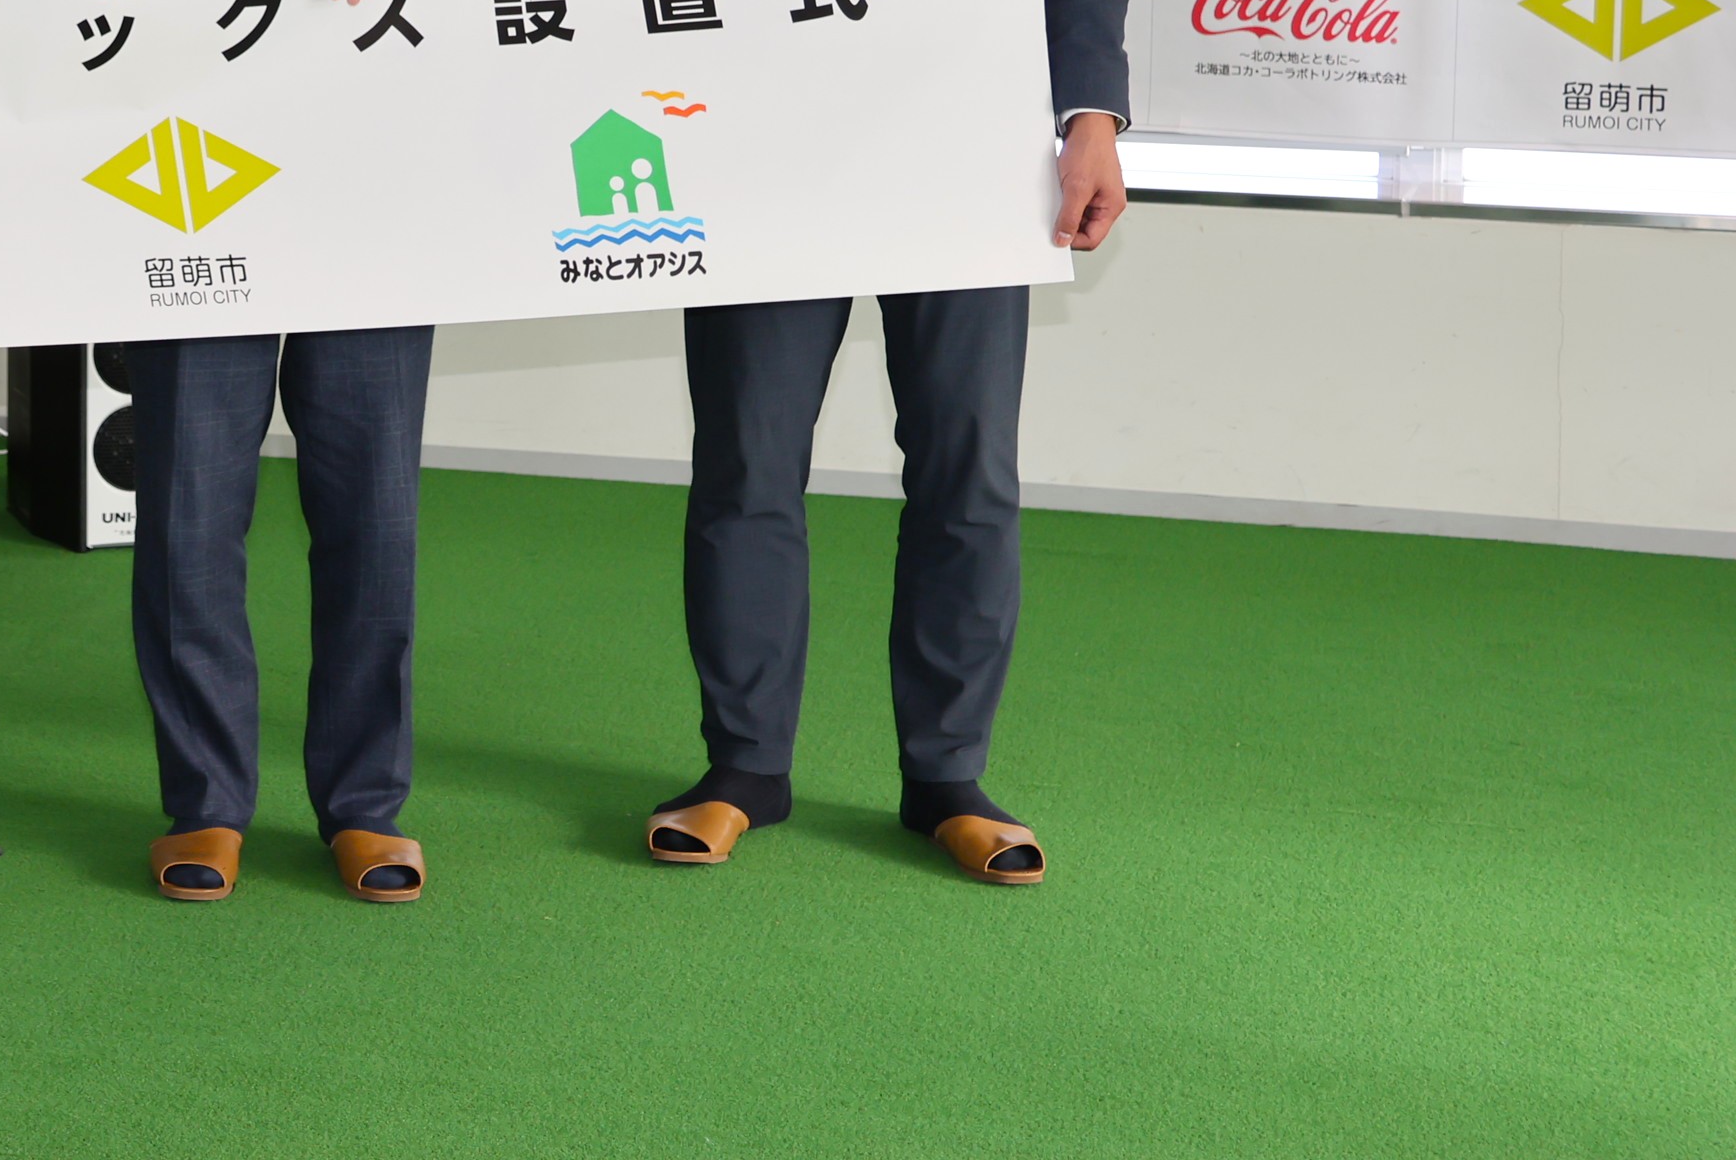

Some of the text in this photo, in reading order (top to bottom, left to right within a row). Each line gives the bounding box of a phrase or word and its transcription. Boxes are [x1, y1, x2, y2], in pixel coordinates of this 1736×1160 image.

[1195, 63, 1407, 85] 北海道コカ・コーラボトリング株式会社
[1563, 82, 1668, 114] 留萌市
[1563, 115, 1667, 132] RUMOI CITY
[145, 254, 247, 288] 留萌市
[560, 251, 706, 283] みなとオアシス
[150, 289, 251, 307] RUMOI CITY
